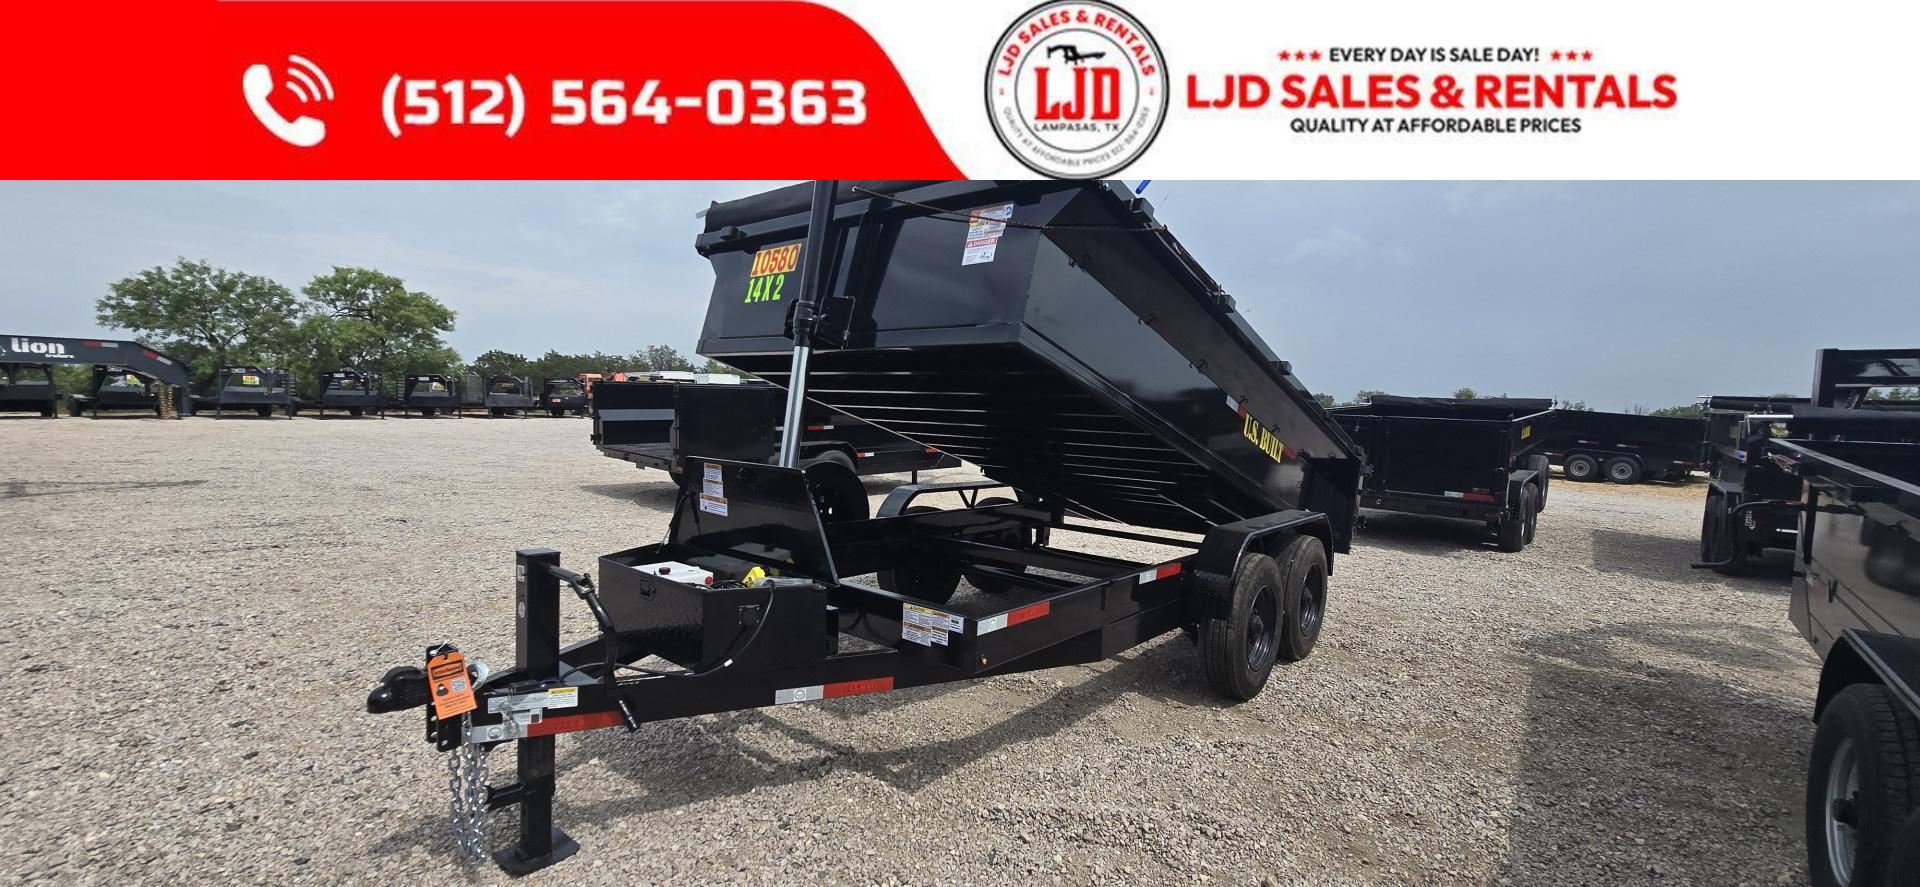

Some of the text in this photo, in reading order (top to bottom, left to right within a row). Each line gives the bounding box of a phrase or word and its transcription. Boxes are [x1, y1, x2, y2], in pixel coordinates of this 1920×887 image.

[972, 239, 995, 247] DANGER
[752, 245, 800, 277] 10580
[11, 337, 65, 354] lion
[1243, 413, 1284, 464] U.S. BUILT
